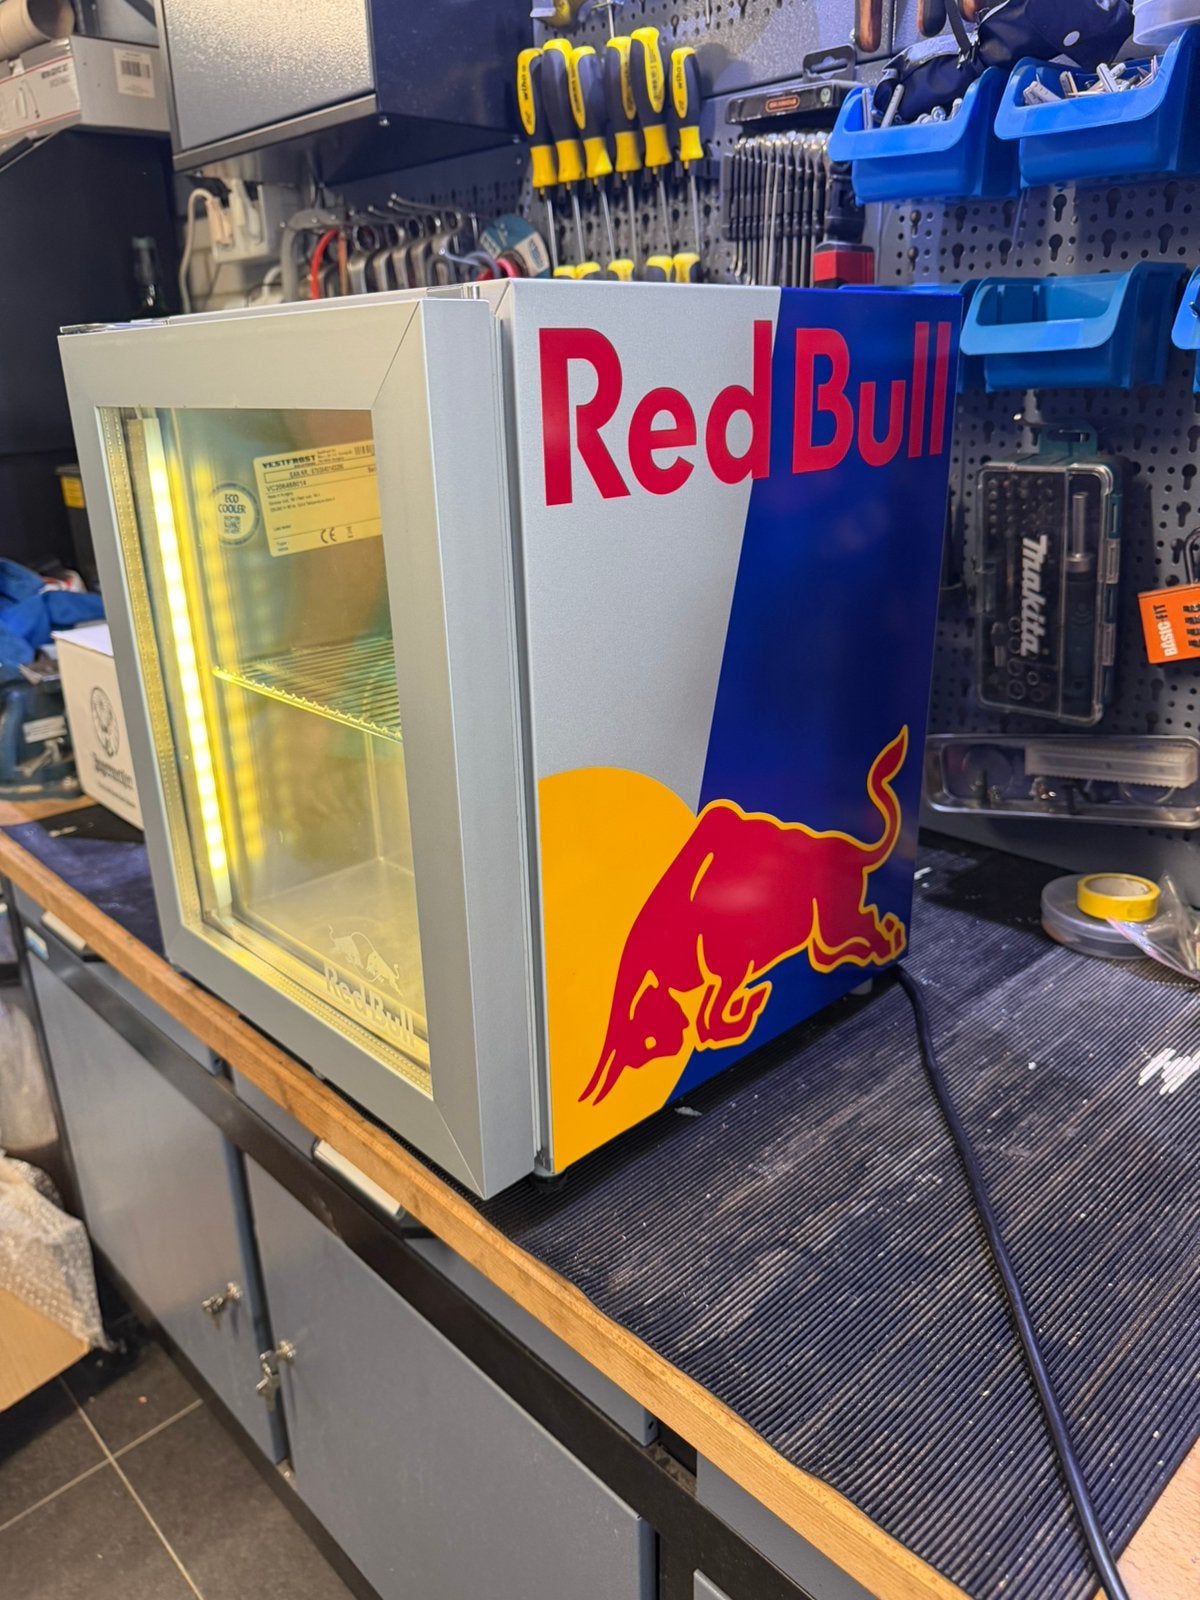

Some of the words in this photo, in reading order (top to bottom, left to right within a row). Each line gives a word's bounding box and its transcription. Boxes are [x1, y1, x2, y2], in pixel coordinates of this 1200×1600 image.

[539, 319, 773, 506] Red
[792, 321, 951, 474] Bull
[218, 504, 246, 513] COOLER
[224, 494, 239, 503] ECO
[323, 961, 368, 1015] Red
[369, 990, 415, 1048] Bull
